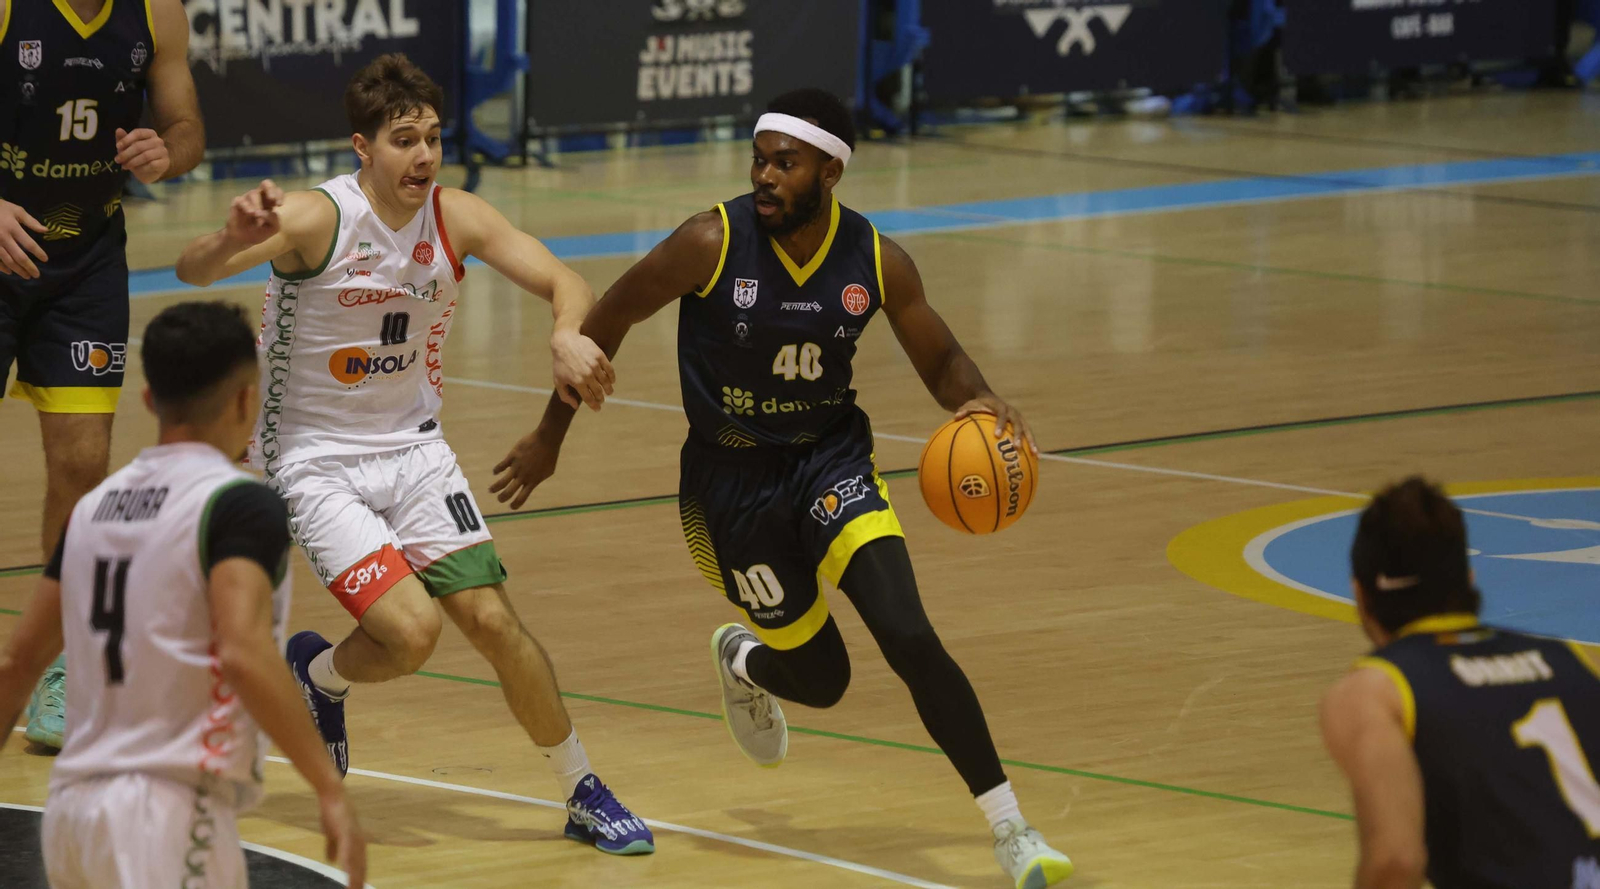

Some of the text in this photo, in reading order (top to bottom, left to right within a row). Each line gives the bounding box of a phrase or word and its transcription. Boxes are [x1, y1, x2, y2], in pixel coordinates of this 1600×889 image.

[186, 0, 420, 51] CENTRAL
[677, 29, 754, 61] MUSIC
[637, 60, 753, 100] EVENTS
[56, 98, 98, 141] 15
[380, 311, 411, 346] 10
[772, 342, 824, 381] 40
[997, 438, 1024, 518] Wilson
[91, 486, 169, 523] MAURA
[445, 491, 481, 535] 10
[731, 563, 785, 610] 40
[90, 556, 132, 688] 4
